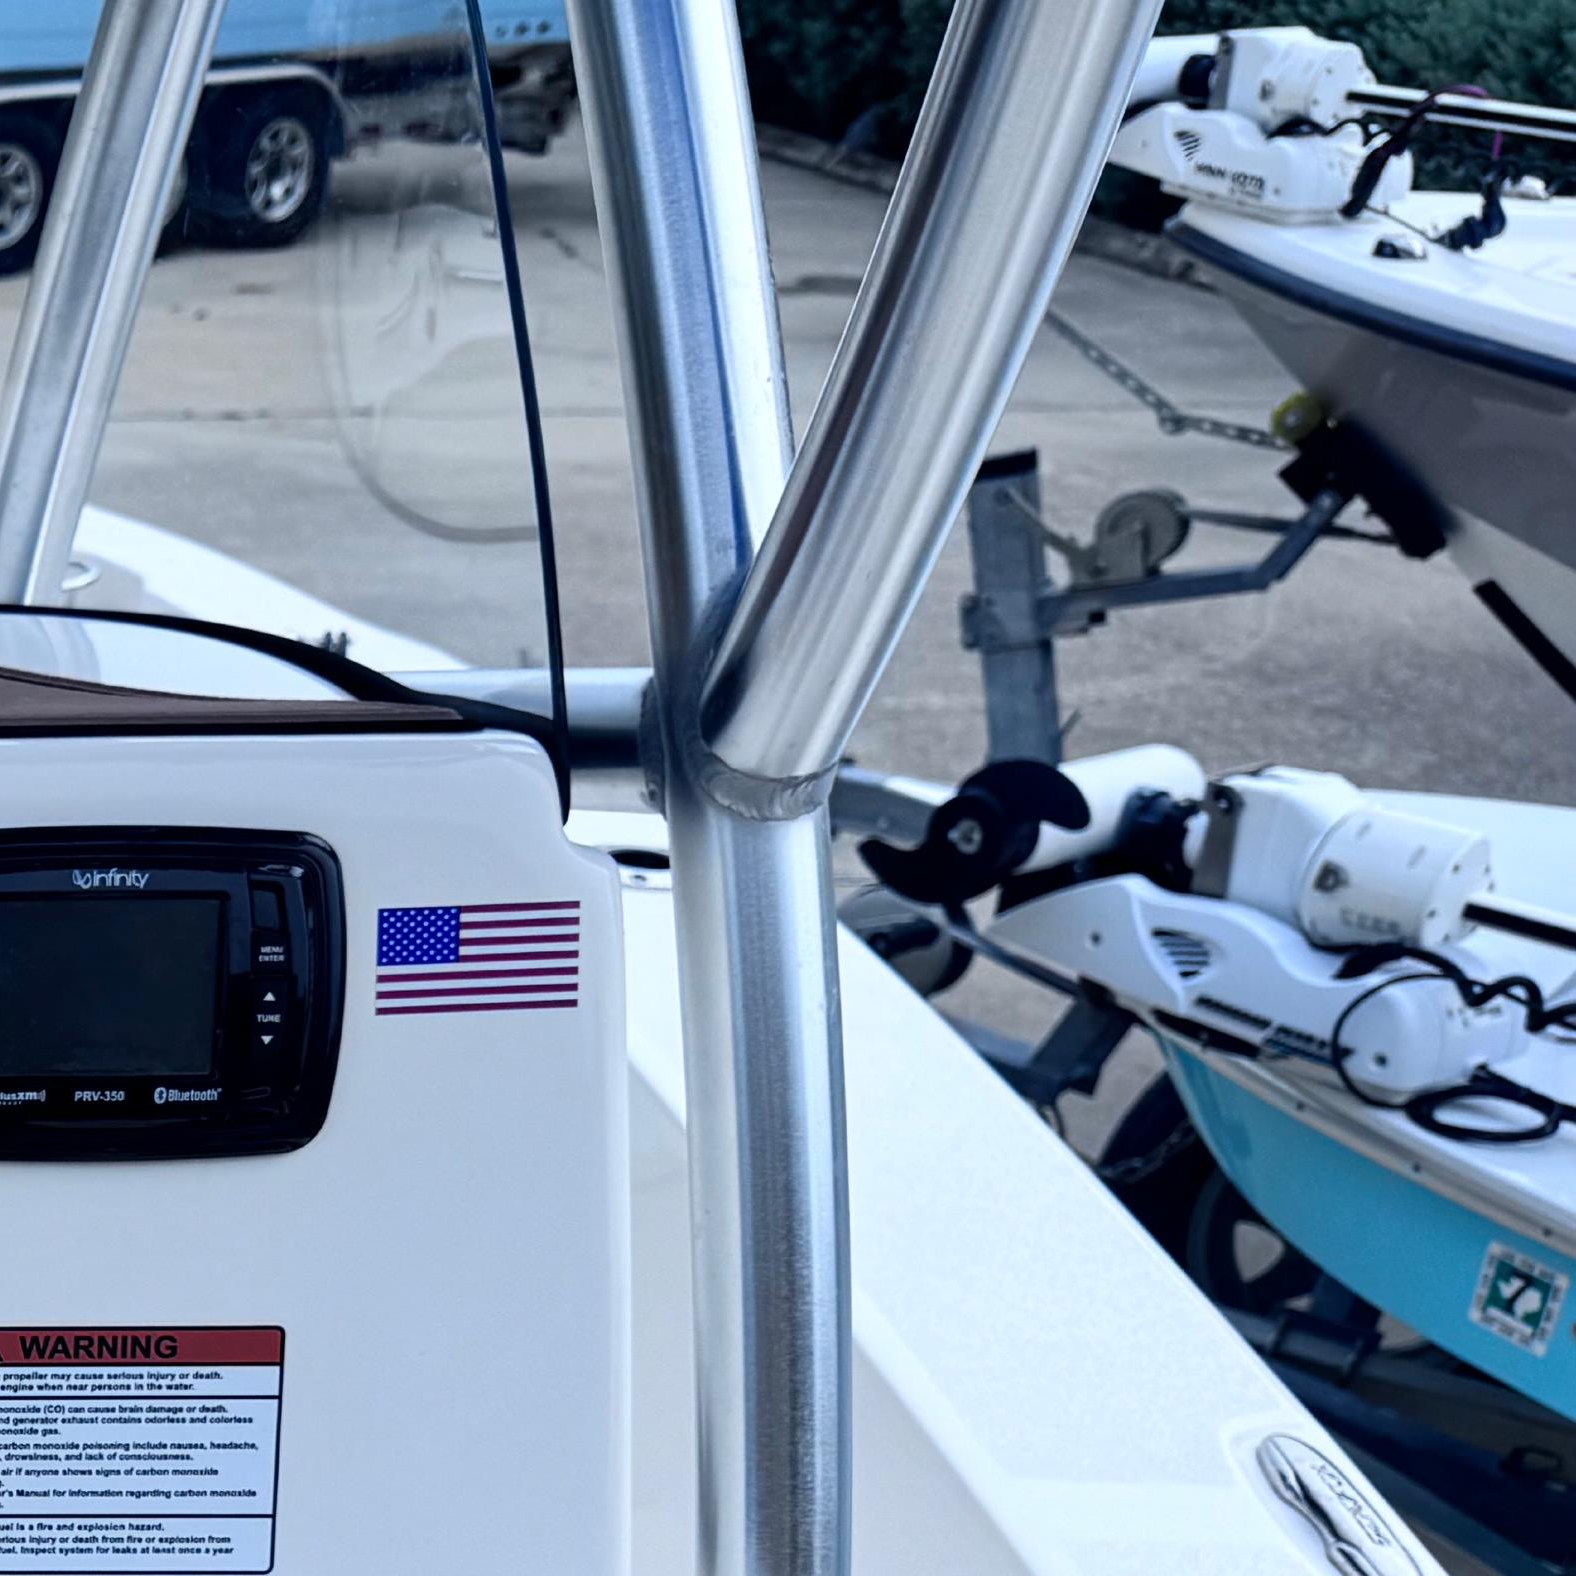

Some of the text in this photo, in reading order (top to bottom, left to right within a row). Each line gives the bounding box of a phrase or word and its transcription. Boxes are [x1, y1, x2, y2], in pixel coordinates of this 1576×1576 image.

[256, 1013, 281, 1022] TUNE
[74, 1090, 125, 1101] PRV-350
[167, 1088, 217, 1101] Bluetooth
[18, 1334, 178, 1360] WARNING
[2, 1371, 48, 1382] propeller
[50, 1373, 71, 1381] may
[106, 1371, 144, 1380] serious
[146, 1371, 176, 1381] injury
[192, 1370, 223, 1379] death.
[0, 1382, 34, 1393] engine
[36, 1382, 63, 1391] when
[65, 1383, 88, 1391] near
[90, 1383, 131, 1392] persons
[134, 1382, 144, 1390] in
[146, 1382, 163, 1390] the
[164, 1382, 194, 1390] water.
[43, 1404, 65, 1415] (CO)
[118, 1404, 143, 1413] brain
[145, 1404, 184, 1415] damage
[198, 1404, 228, 1413] death.
[12, 1416, 58, 1426] generator
[60, 1415, 98, 1424] exhaust
[100, 1415, 142, 1424] contains
[144, 1415, 186, 1424] odorless
[188, 1415, 207, 1423] and
[208, 1415, 253, 1424] colorless
[40, 1428, 61, 1437] gas.
[15, 1522, 25, 1530] is
[27, 1523, 34, 1531] a
[36, 1522, 53, 1530] fire
[55, 1522, 74, 1531] and
[76, 1522, 126, 1532] explosion
[128, 1522, 164, 1531] hazard.
